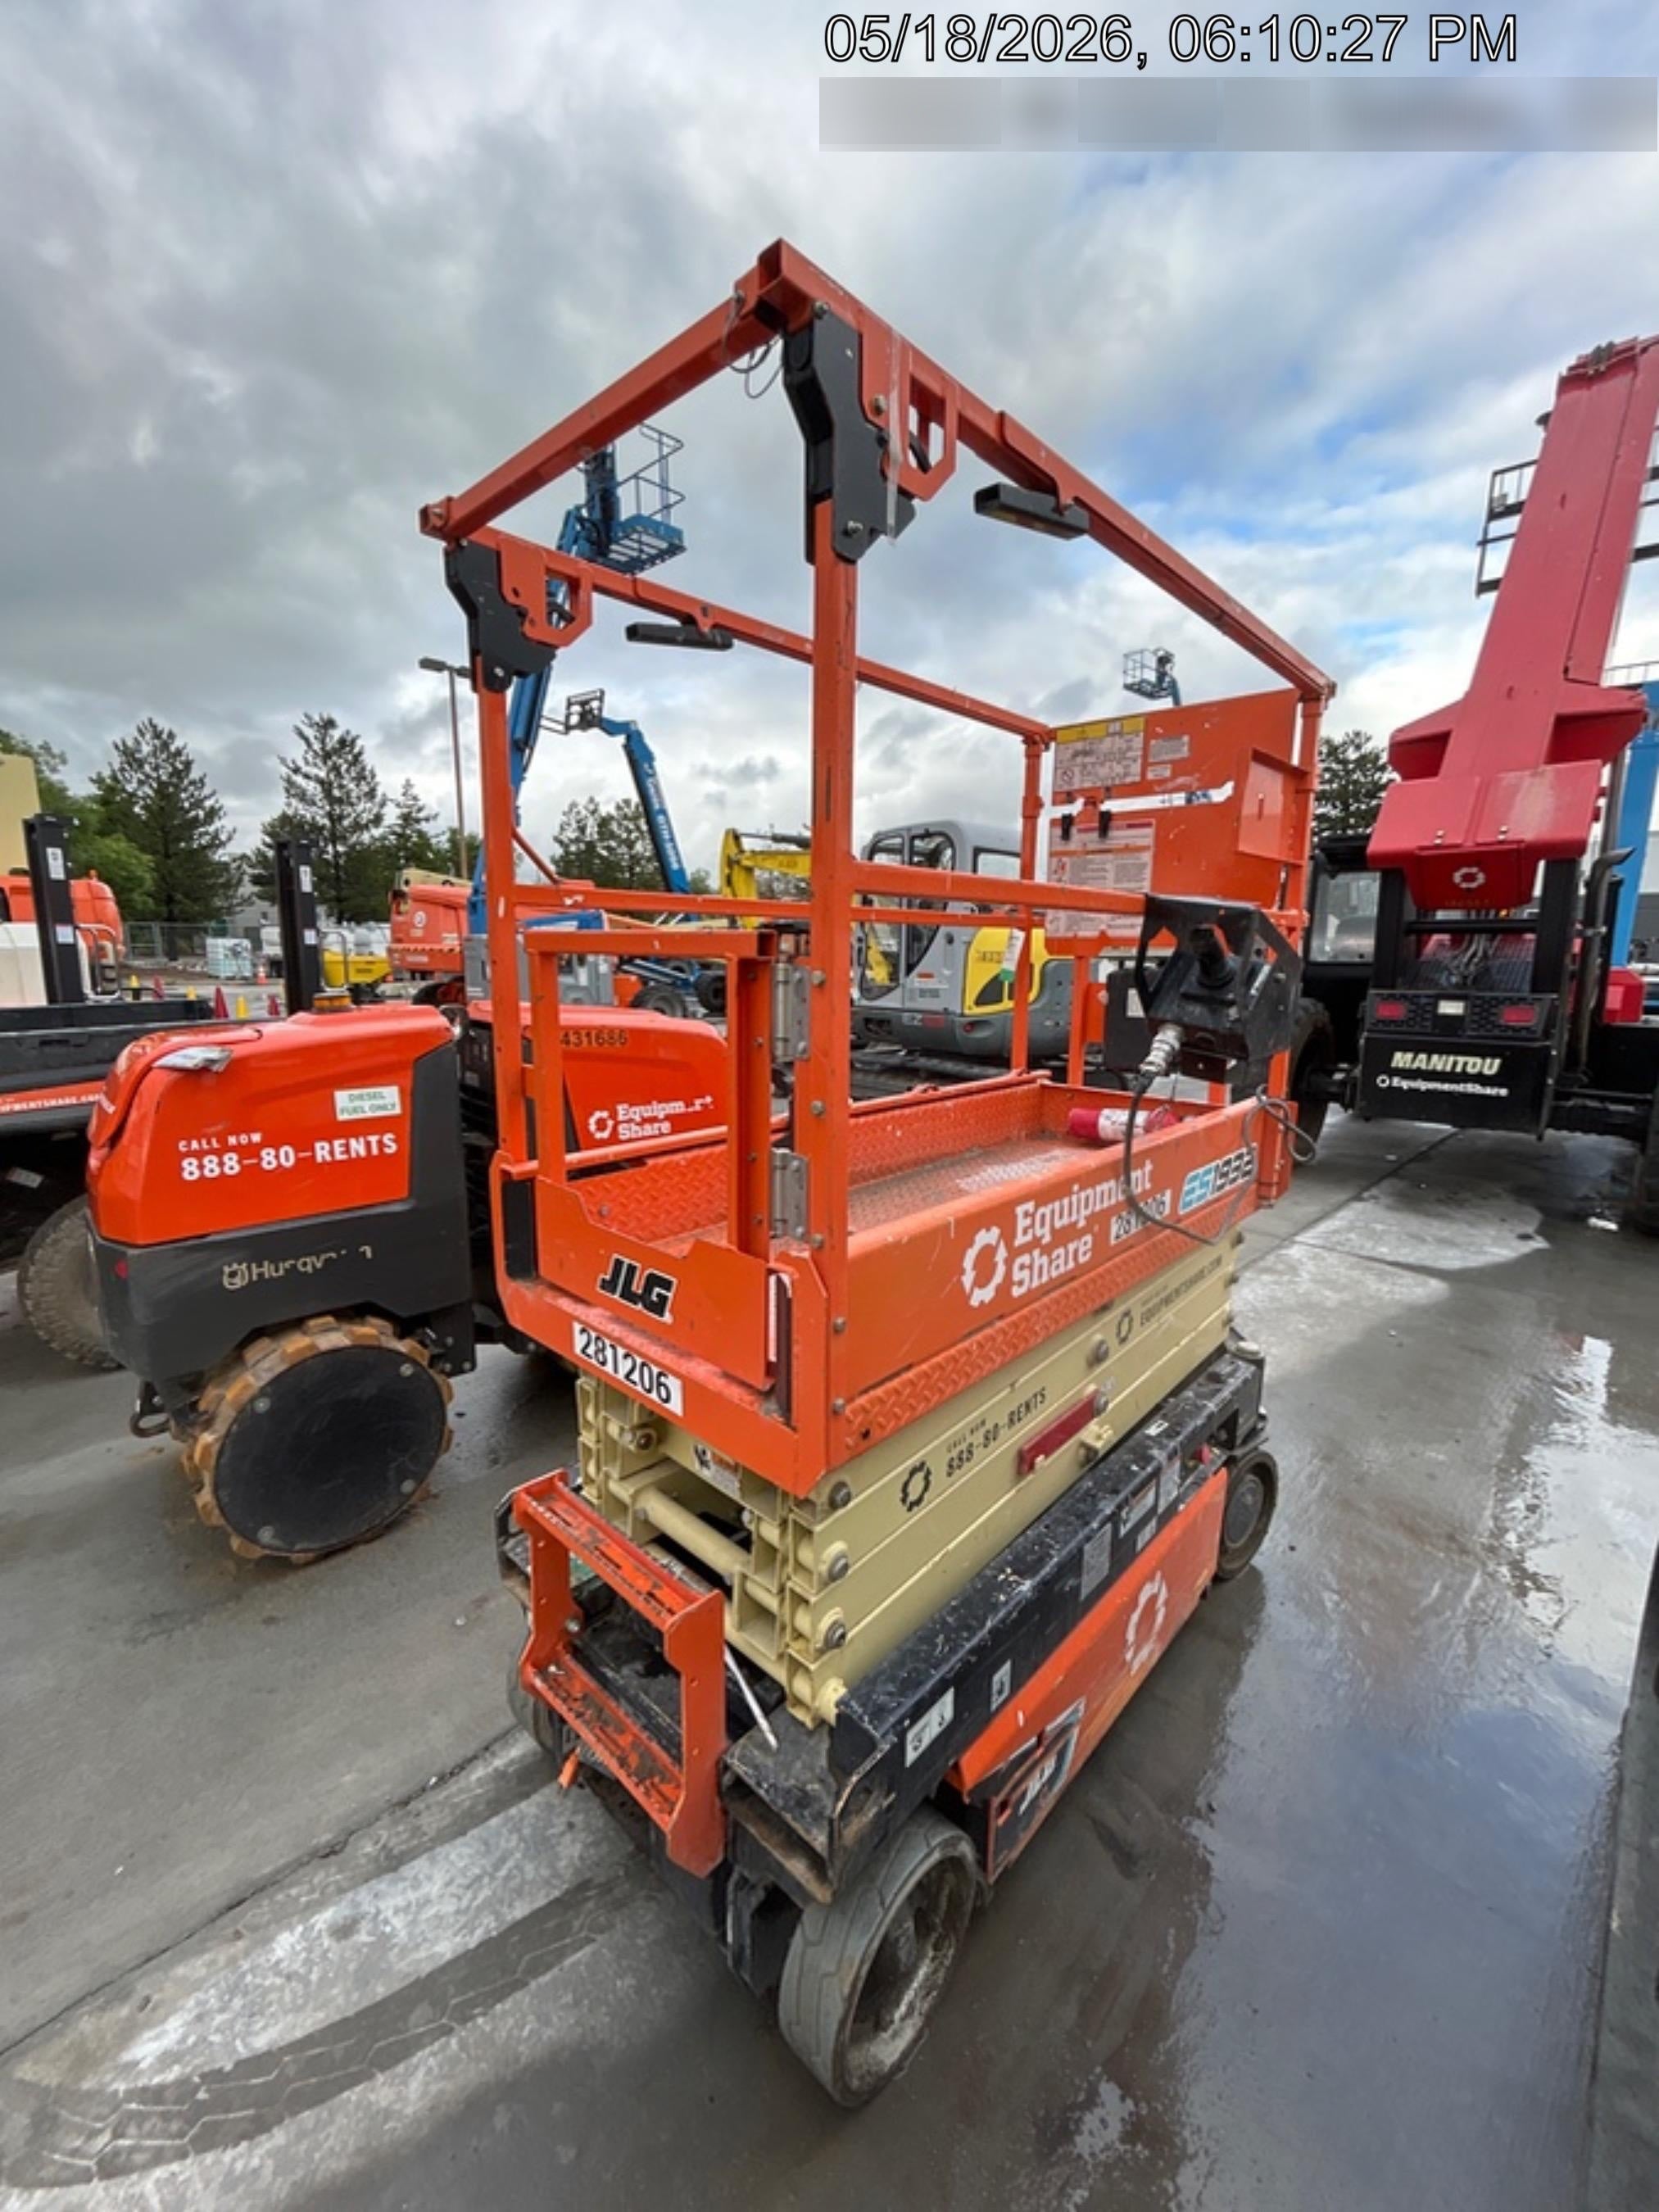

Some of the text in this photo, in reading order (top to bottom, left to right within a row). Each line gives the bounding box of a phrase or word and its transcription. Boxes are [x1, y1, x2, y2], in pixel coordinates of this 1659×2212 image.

[1391, 1051, 1502, 1075] MANITOU
[178, 1131, 263, 1153] CALL NOW
[181, 1132, 398, 1181] 888-80-RENTS
[617, 1119, 672, 1140] Share
[598, 1256, 675, 1320] JLG
[1011, 1234, 1093, 1299] Share
[578, 1326, 673, 1405] 281206
[945, 1385, 1046, 1479] 888-80-RENTS
